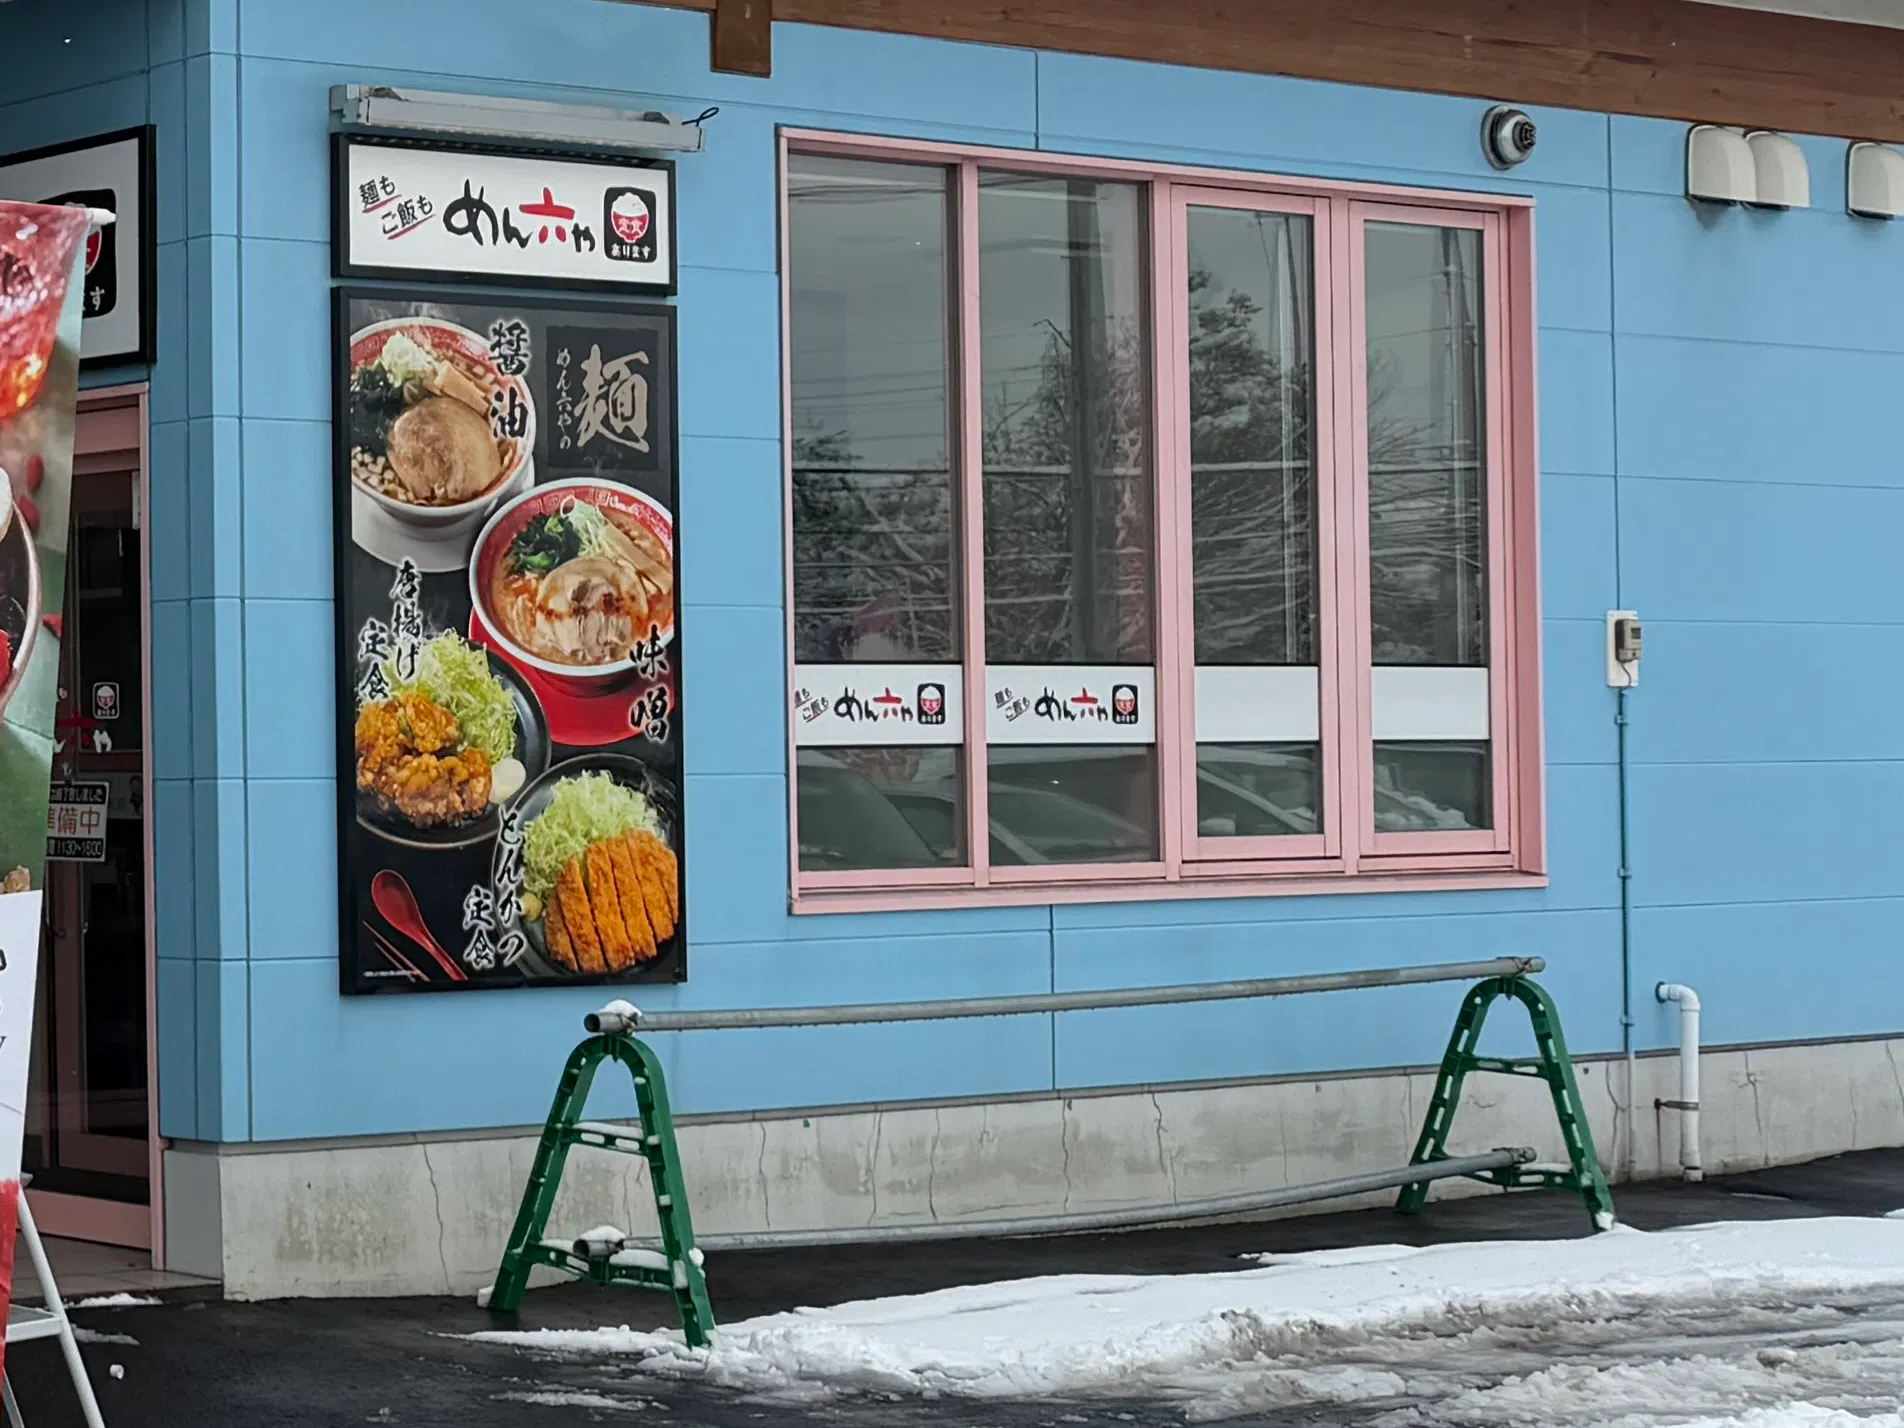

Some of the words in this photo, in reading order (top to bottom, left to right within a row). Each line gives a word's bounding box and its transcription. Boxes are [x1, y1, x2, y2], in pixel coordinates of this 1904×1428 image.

[380, 195, 433, 235] ご飯も
[442, 179, 596, 254] めん六や
[611, 242, 652, 260] あります
[389, 559, 422, 680] 唐揚げ
[357, 621, 390, 701] 定食
[834, 686, 913, 722] めん六や
[1035, 686, 1108, 722] めん六や
[497, 809, 526, 959] とんかつ
[463, 887, 494, 967] 定食
